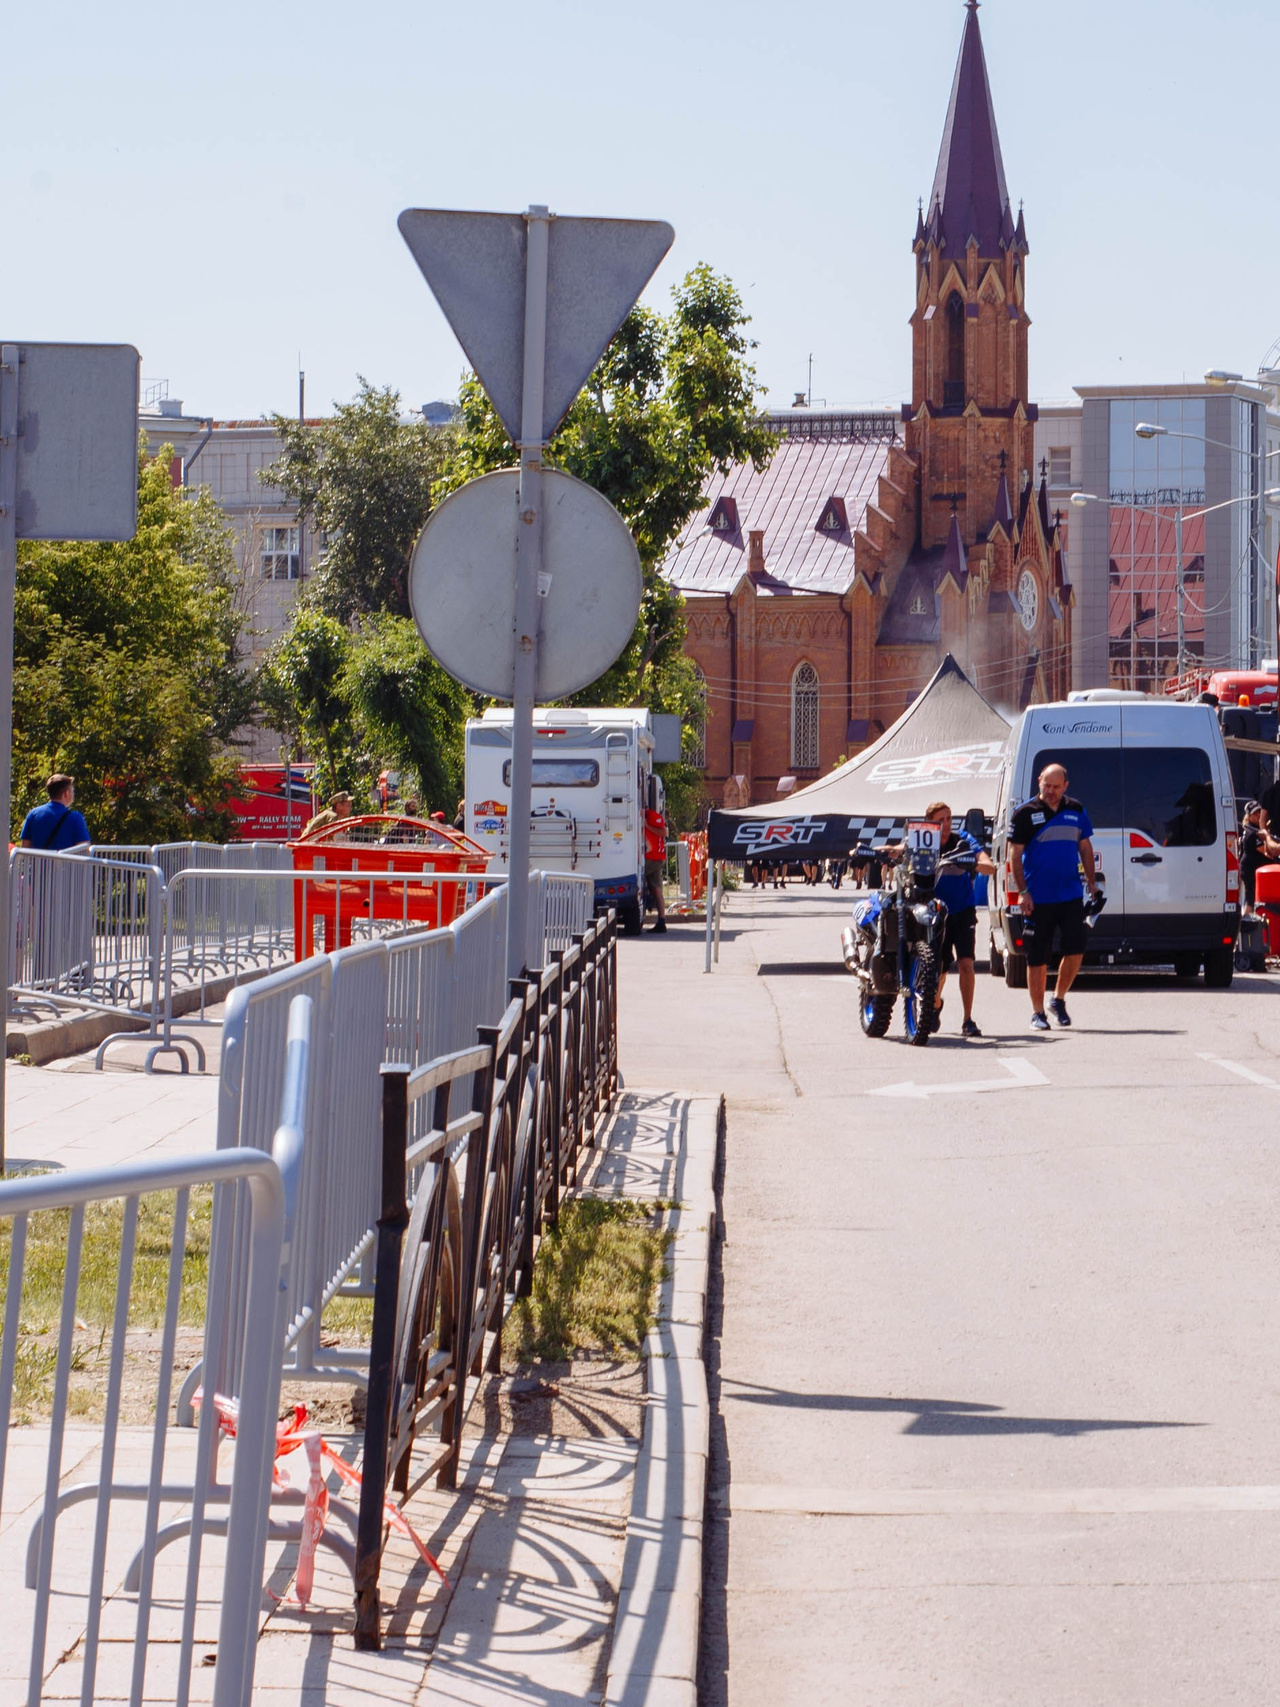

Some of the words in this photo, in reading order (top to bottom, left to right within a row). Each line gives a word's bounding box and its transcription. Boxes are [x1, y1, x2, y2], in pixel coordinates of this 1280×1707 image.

[865, 750, 1005, 782] SRT
[732, 819, 827, 846] SRT
[913, 830, 934, 848] 10
